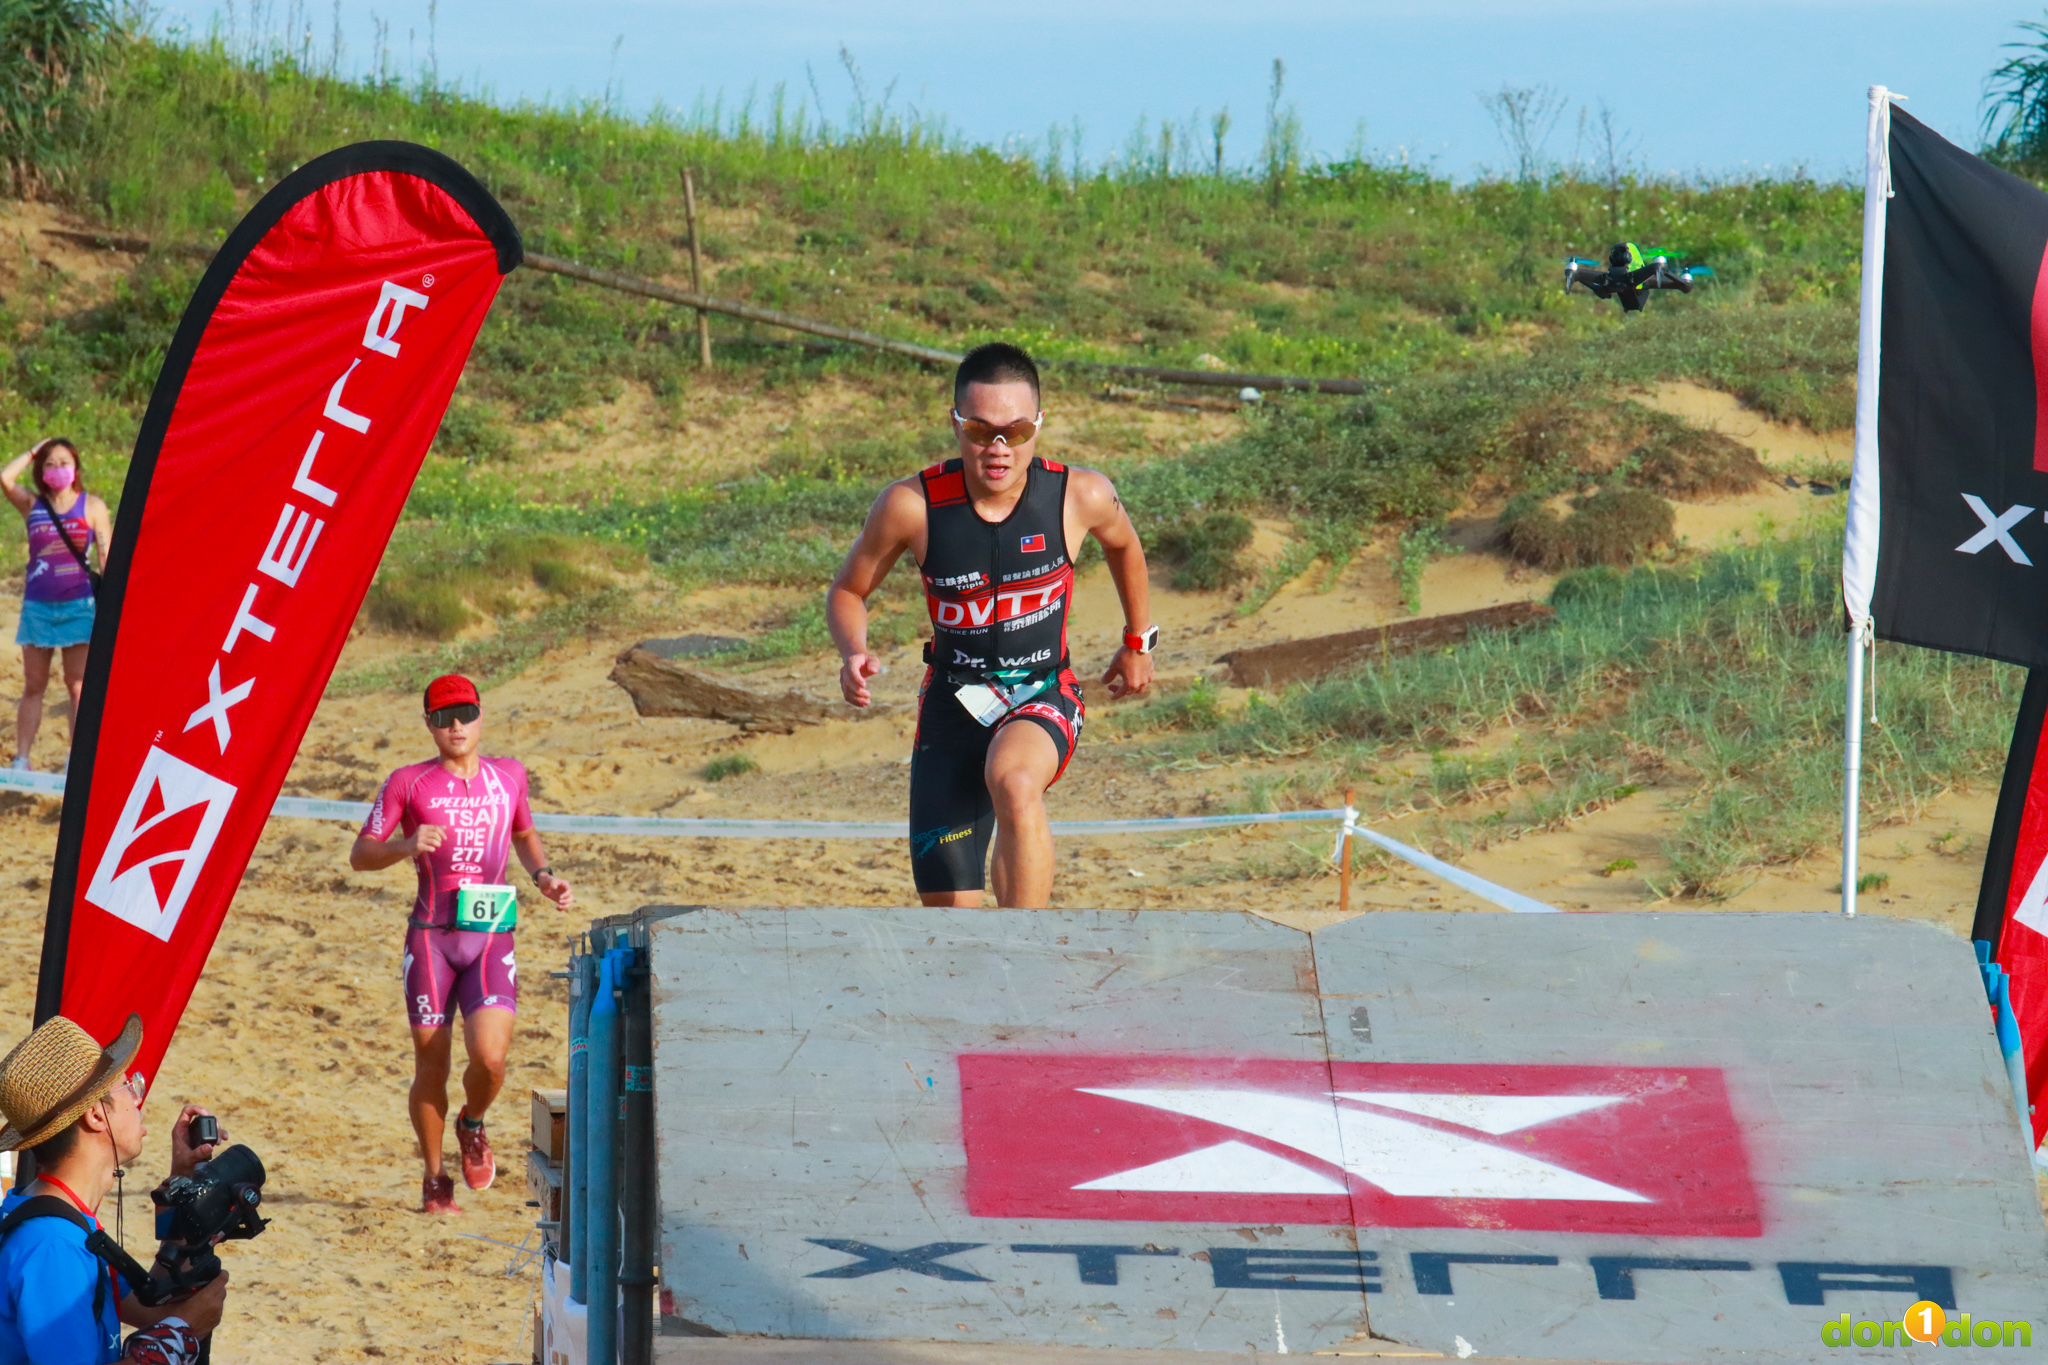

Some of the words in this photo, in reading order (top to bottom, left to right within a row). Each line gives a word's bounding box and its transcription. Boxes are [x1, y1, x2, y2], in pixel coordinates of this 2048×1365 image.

[1954, 492, 2048, 567] X
[956, 580, 985, 591] Triple
[937, 580, 1063, 627] DVTT
[969, 628, 989, 636] RUN
[953, 648, 987, 669] Dr.
[999, 648, 1051, 668] Wells
[427, 793, 510, 809] SPECIALIZED
[444, 807, 498, 827] TSAI
[454, 827, 486, 846] TPE
[939, 827, 973, 845] Fitness
[451, 847, 485, 863] 277
[421, 1013, 445, 1025] 277
